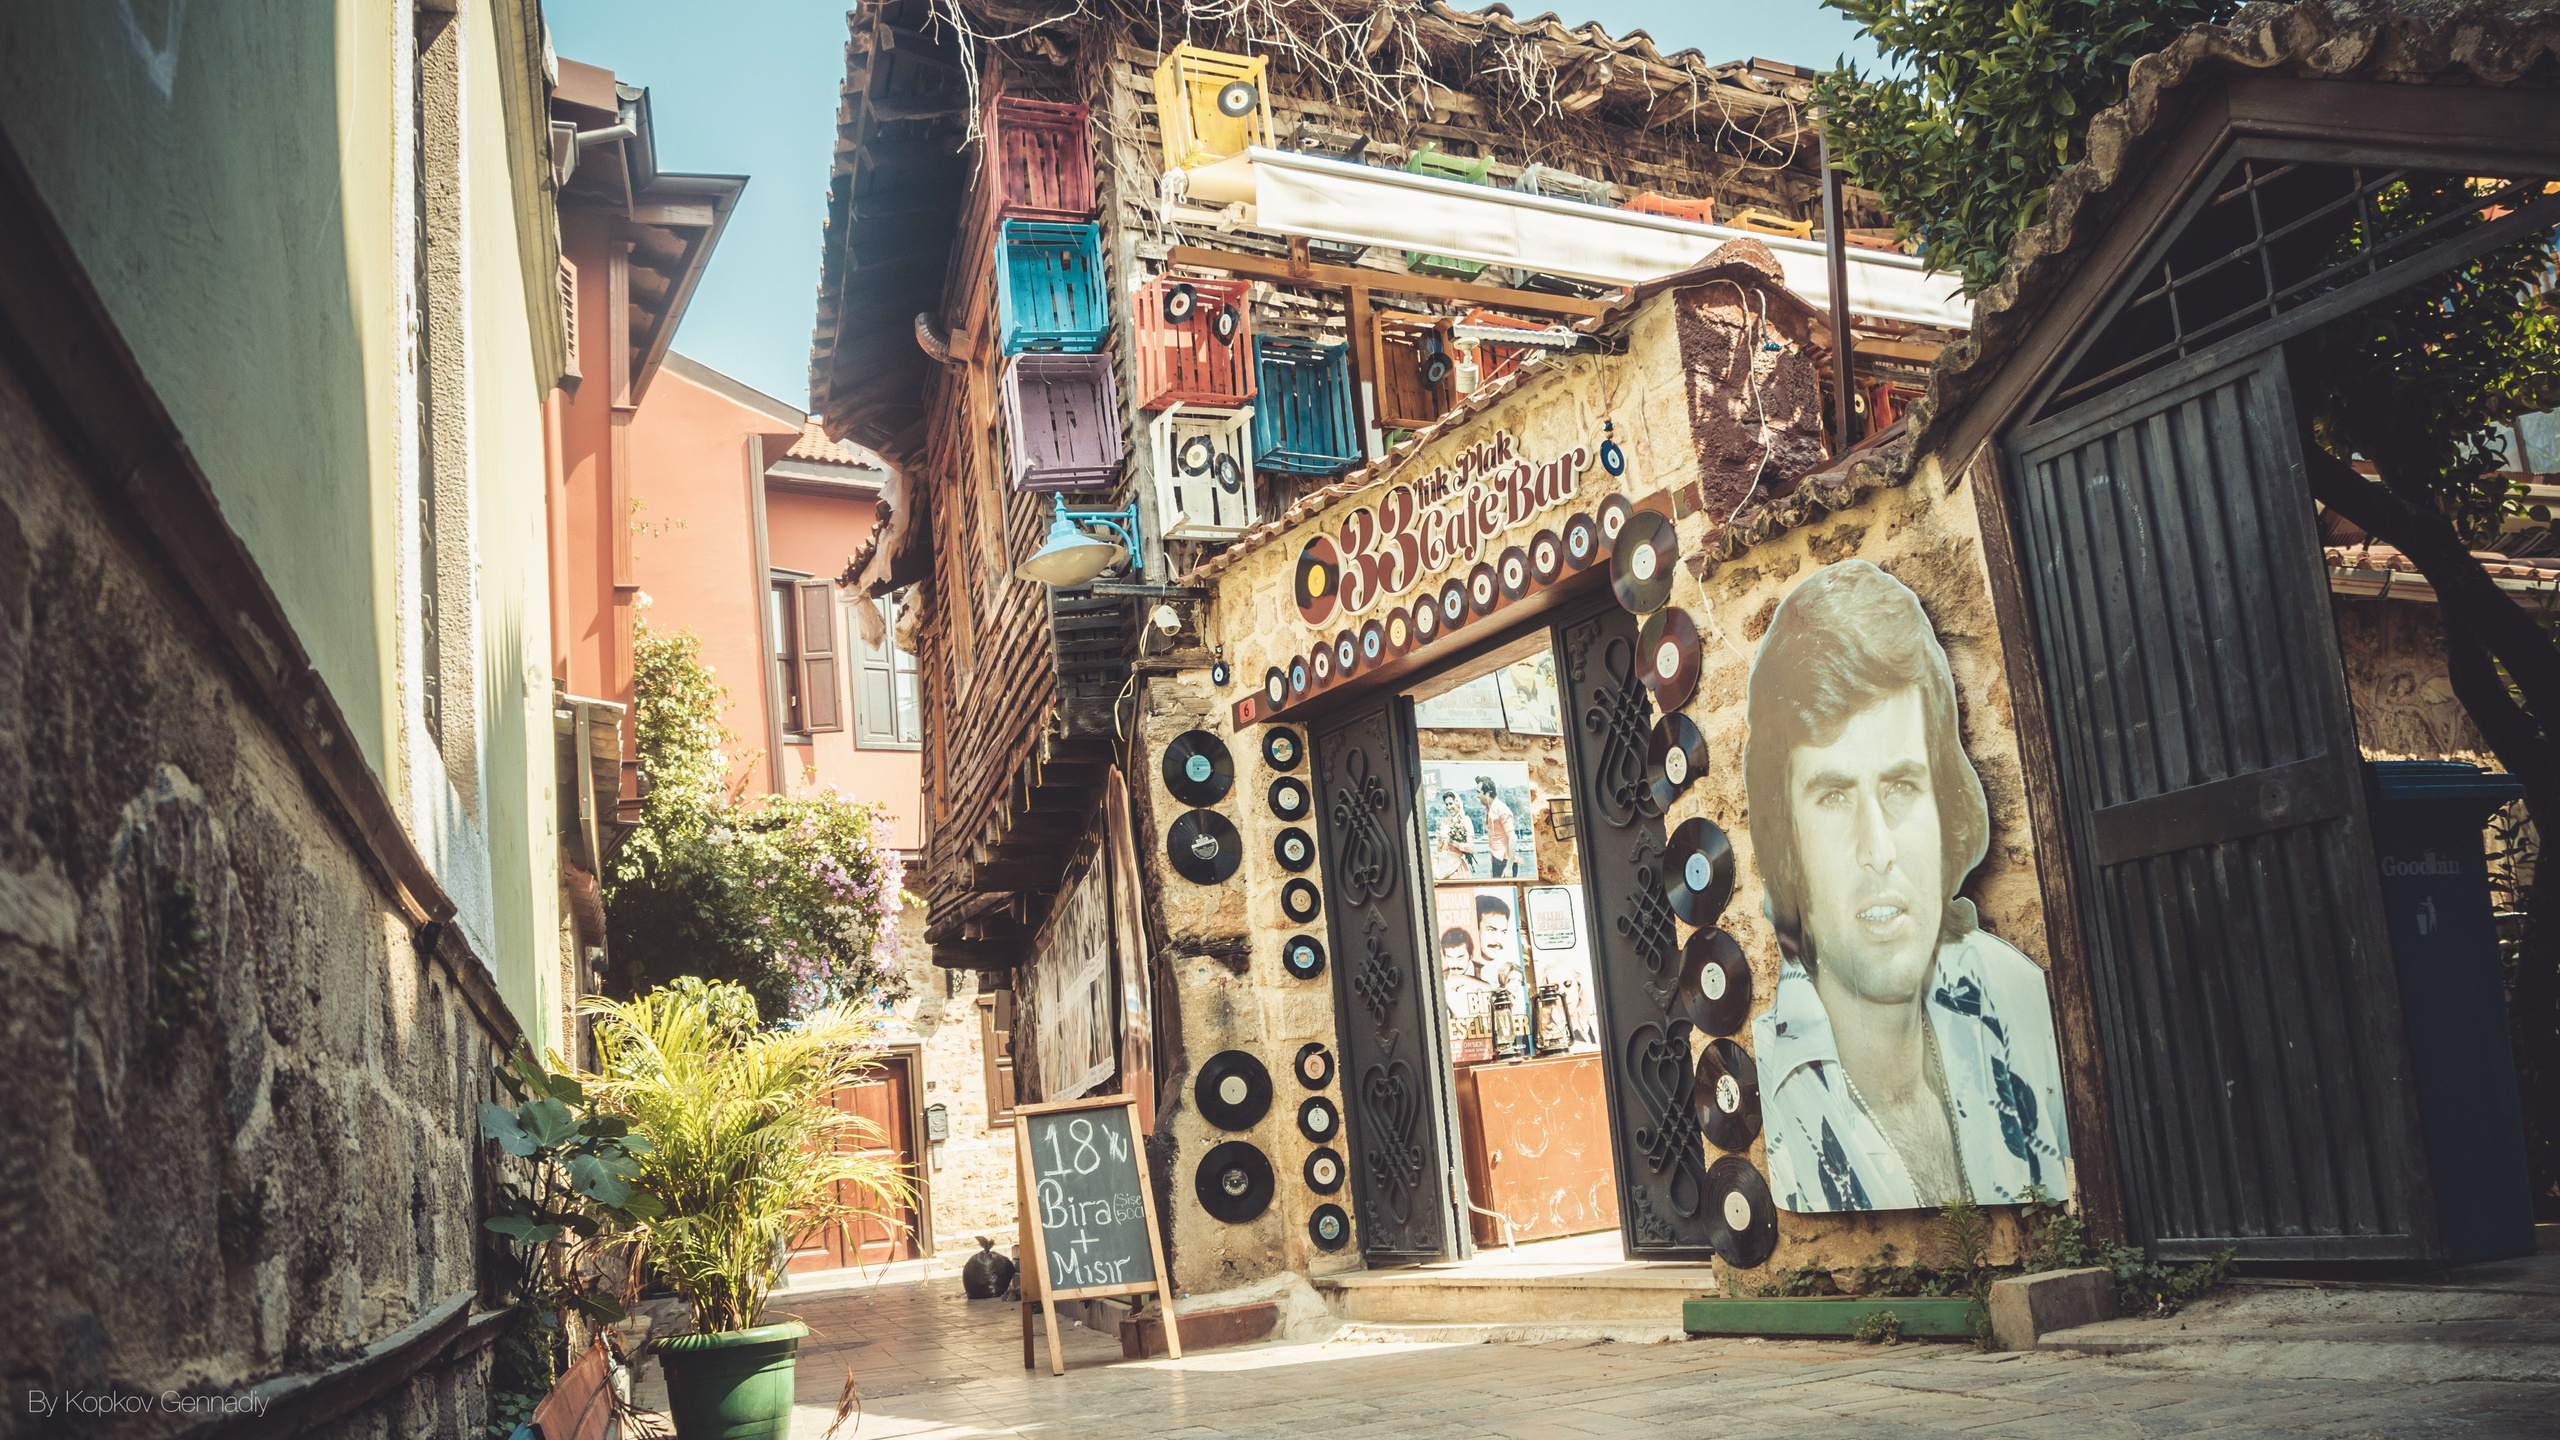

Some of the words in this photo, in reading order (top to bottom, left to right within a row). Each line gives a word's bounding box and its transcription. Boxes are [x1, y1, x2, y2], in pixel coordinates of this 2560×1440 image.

[1453, 430, 1513, 494] Plak
[1419, 485, 1499, 570] Cafe
[1494, 448, 1586, 526] Bar
[1243, 703, 1250, 718] 6
[1044, 1118, 1100, 1177] 18
[1037, 1178, 1112, 1229] Bira
